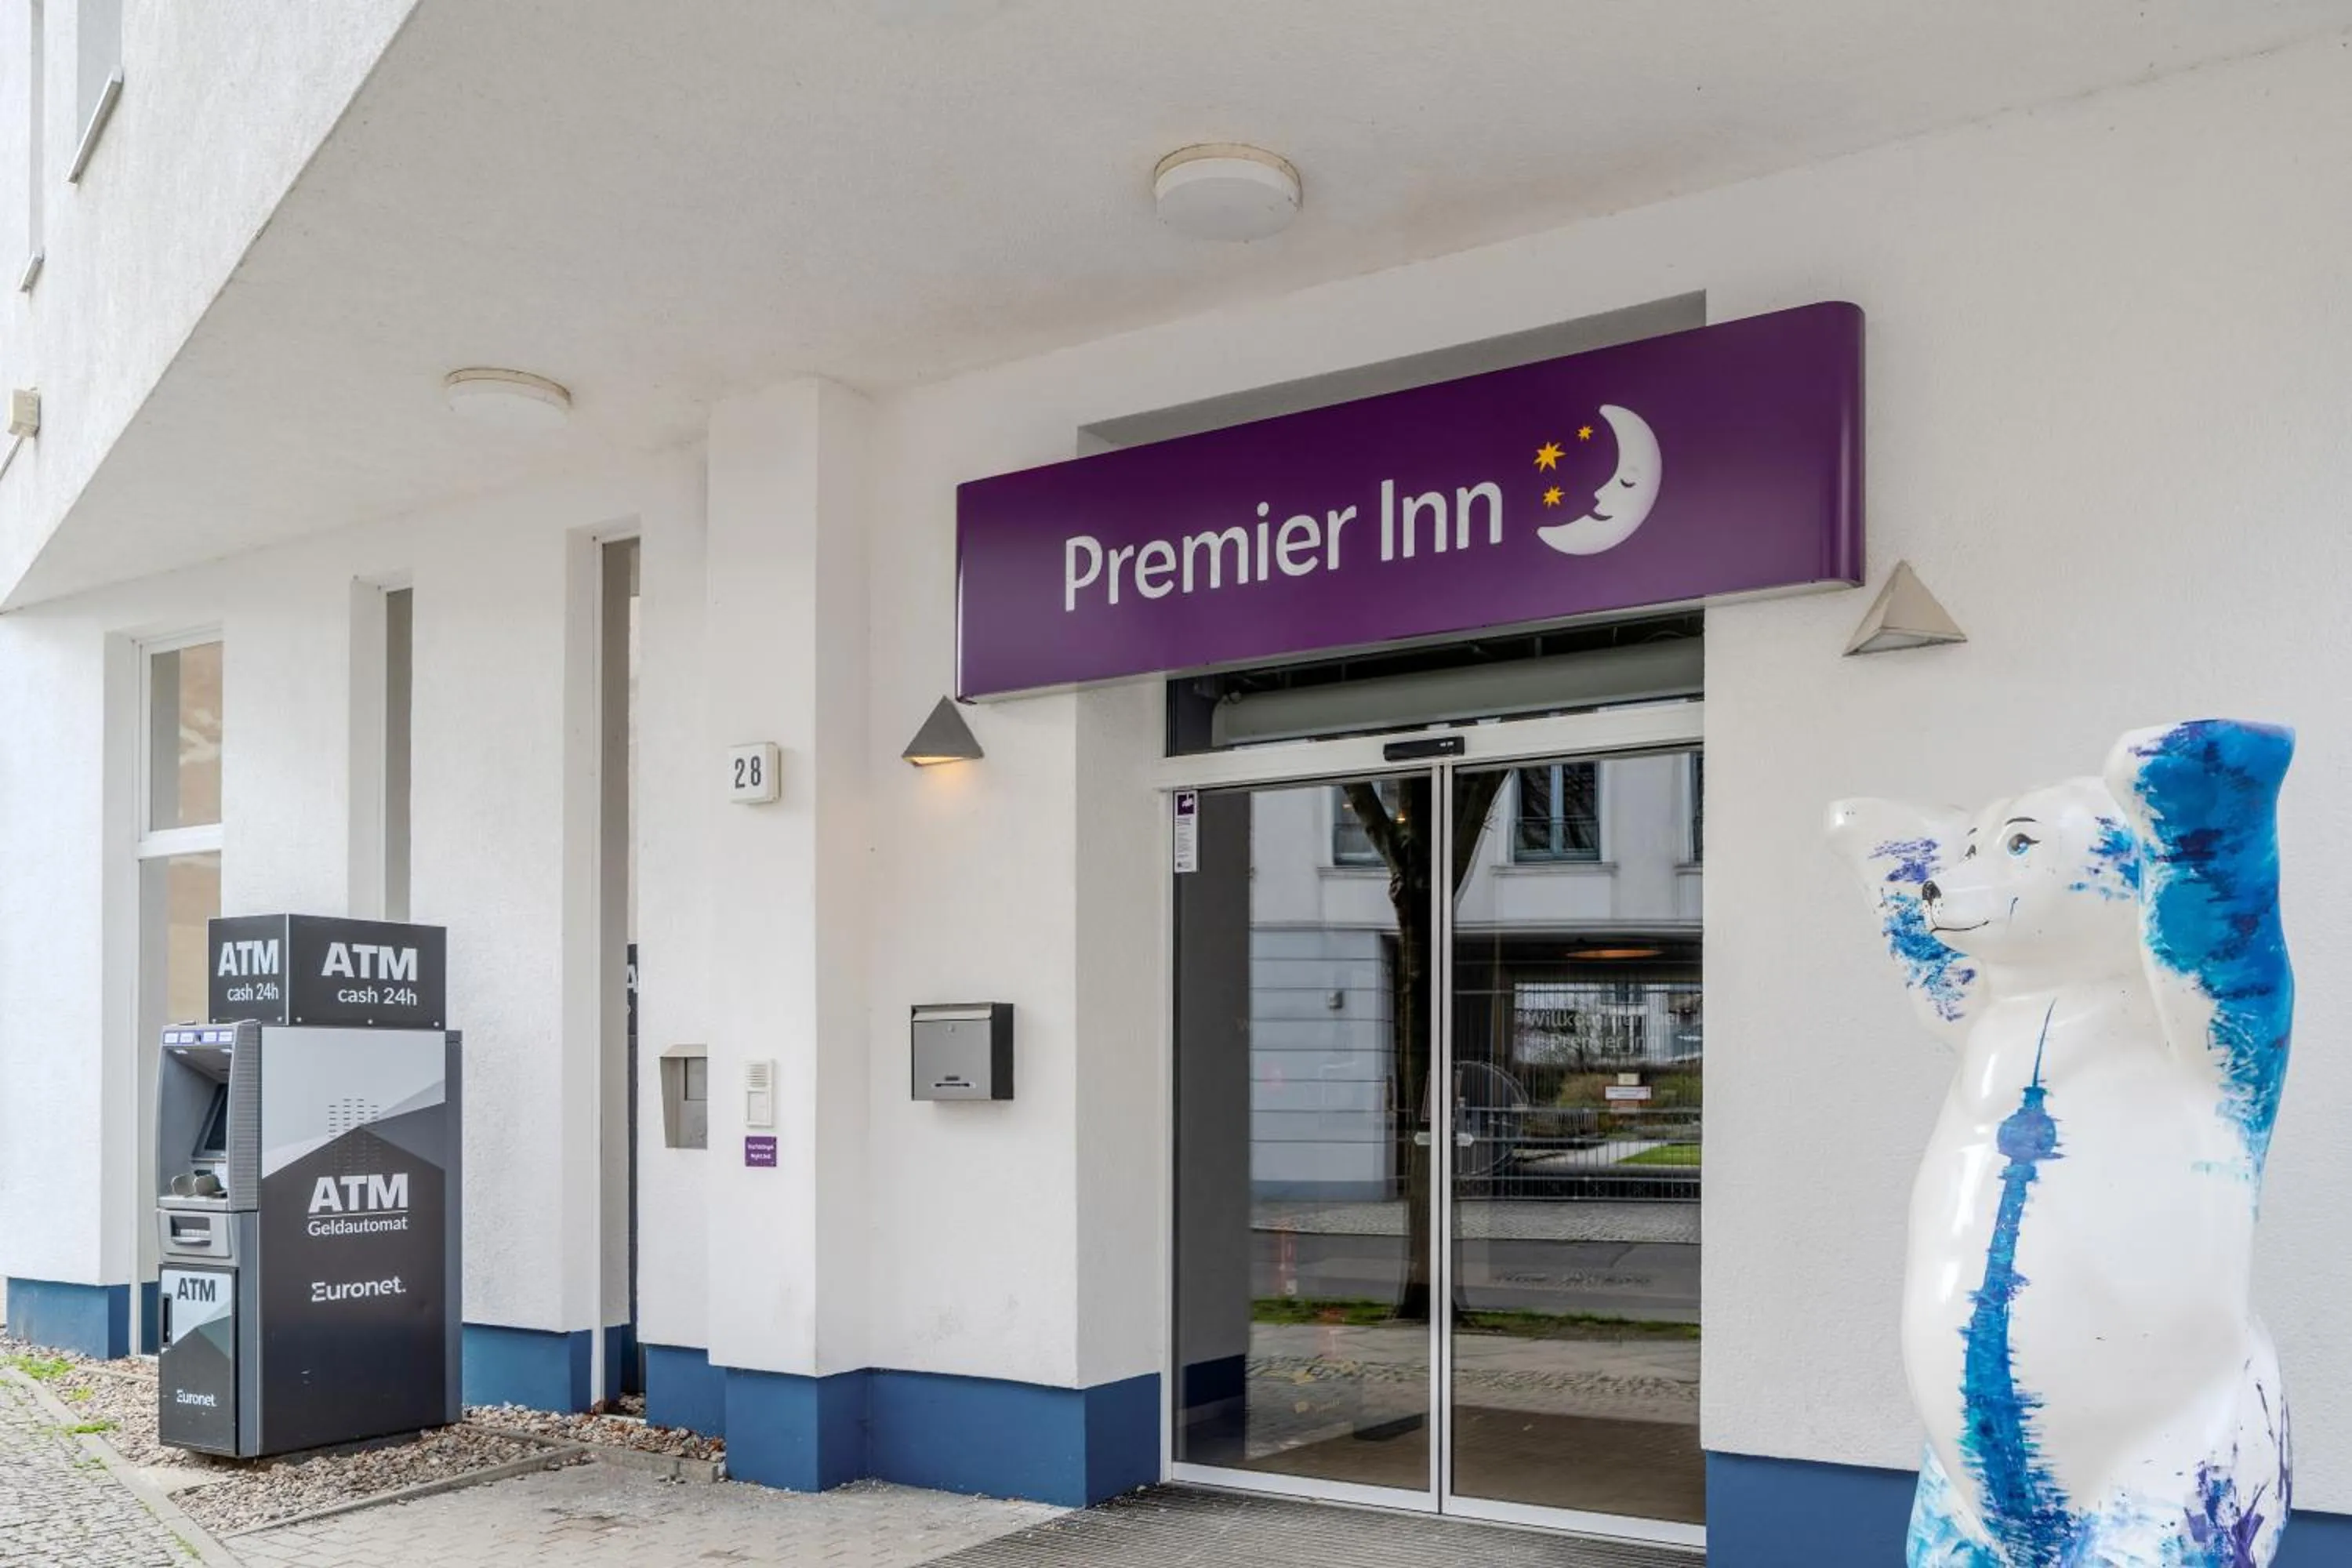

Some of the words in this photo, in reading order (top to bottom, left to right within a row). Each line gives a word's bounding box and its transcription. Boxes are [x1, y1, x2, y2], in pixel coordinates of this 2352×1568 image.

[1064, 500, 1358, 613] Premier
[1381, 479, 1504, 562] Inn
[735, 755, 761, 789] 28
[217, 938, 280, 977] ATM
[321, 942, 419, 982] ATM
[227, 983, 253, 1002] cash
[256, 982, 279, 1001] 24h
[337, 985, 379, 1004] cash
[383, 987, 417, 1006] 24h
[307, 1173, 408, 1214] ATM
[307, 1216, 408, 1236] Geldautomat
[176, 1277, 216, 1303] ATM
